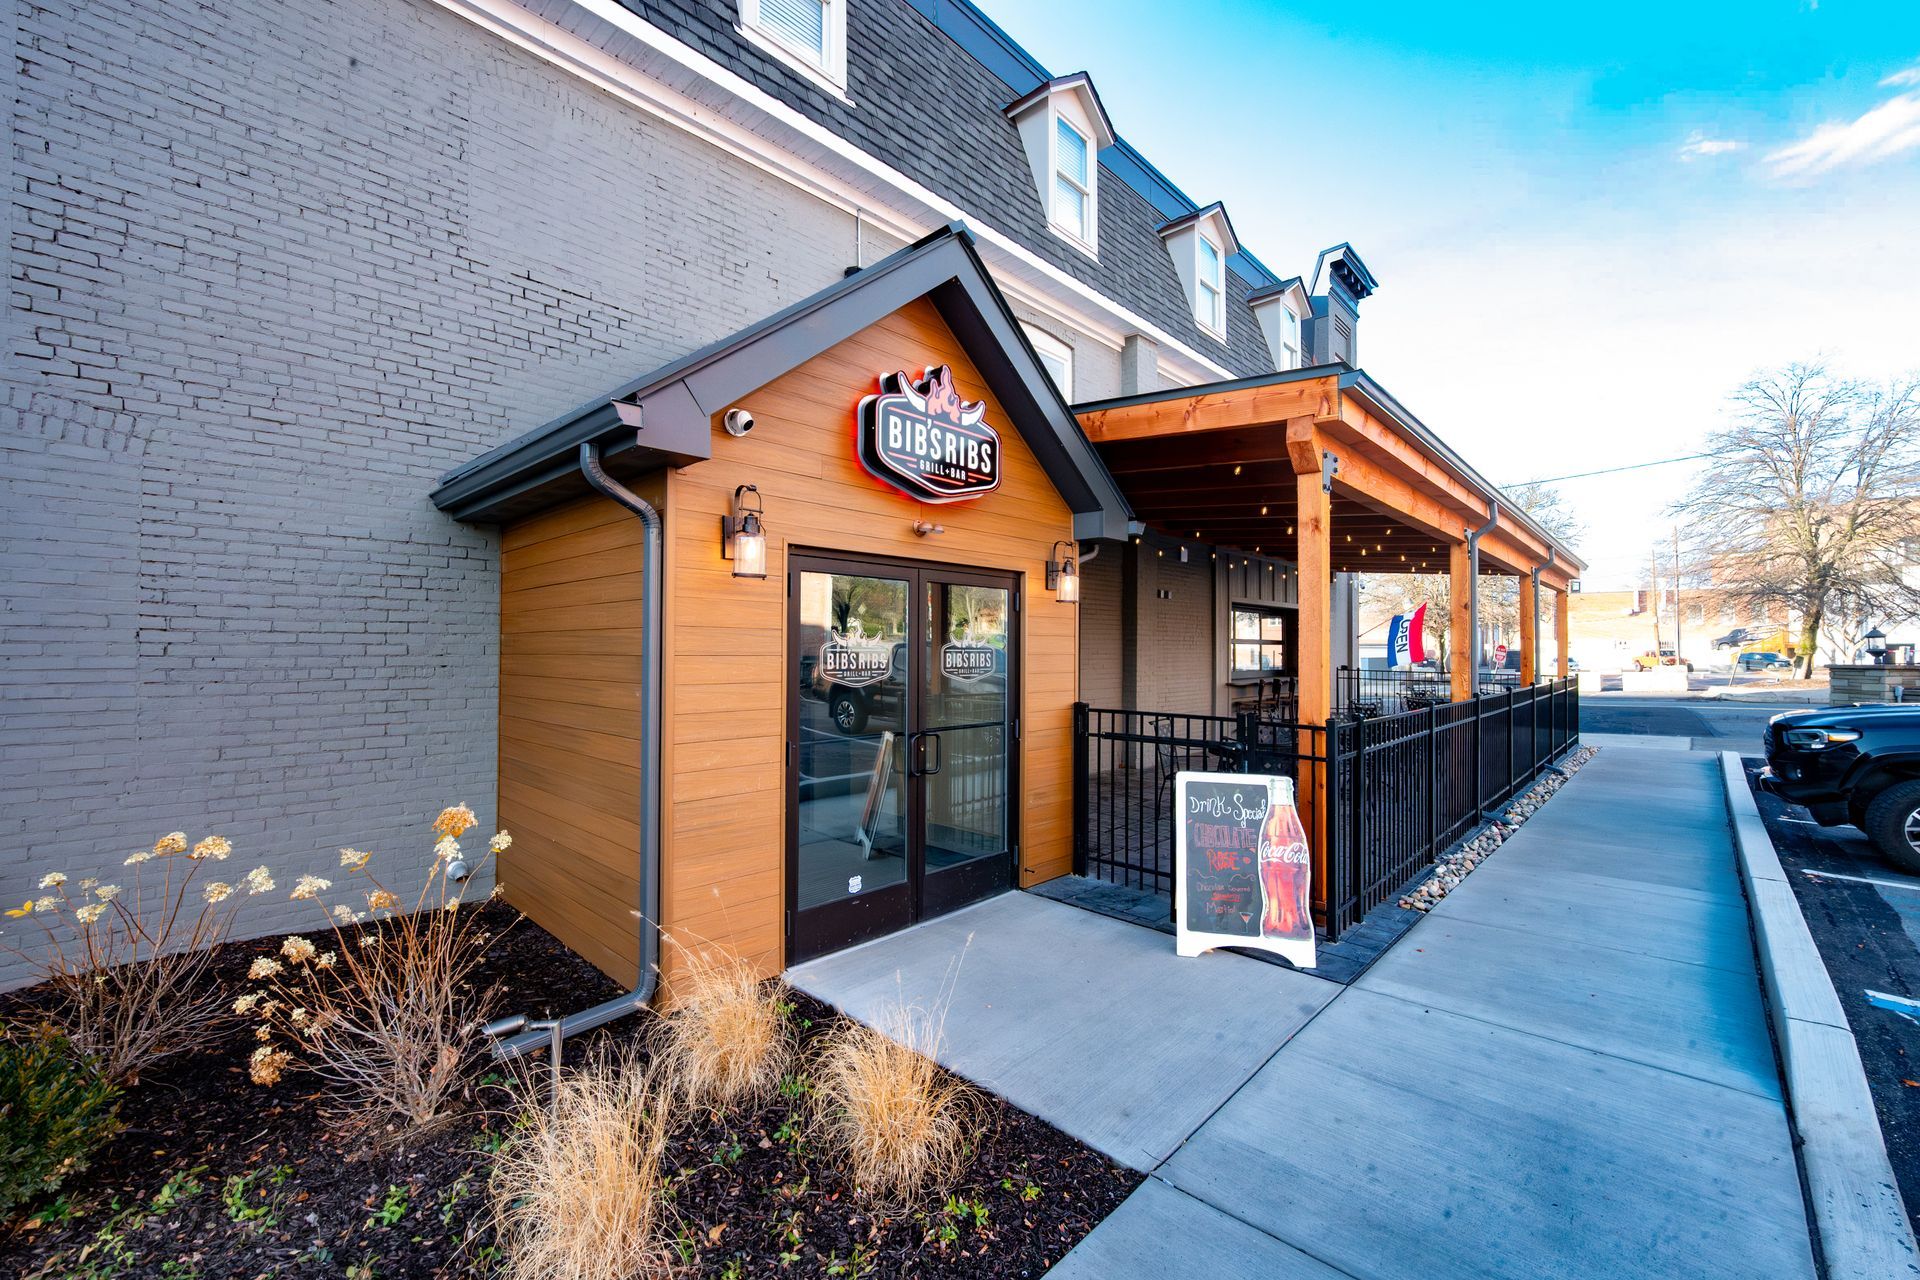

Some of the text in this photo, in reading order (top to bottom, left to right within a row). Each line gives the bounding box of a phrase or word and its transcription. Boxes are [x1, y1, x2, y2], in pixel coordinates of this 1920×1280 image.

[889, 415, 992, 474] BIB'S RIBS
[827, 649, 887, 670] BIB'S RIBS
[946, 650, 991, 667] BIB'S RIBS
